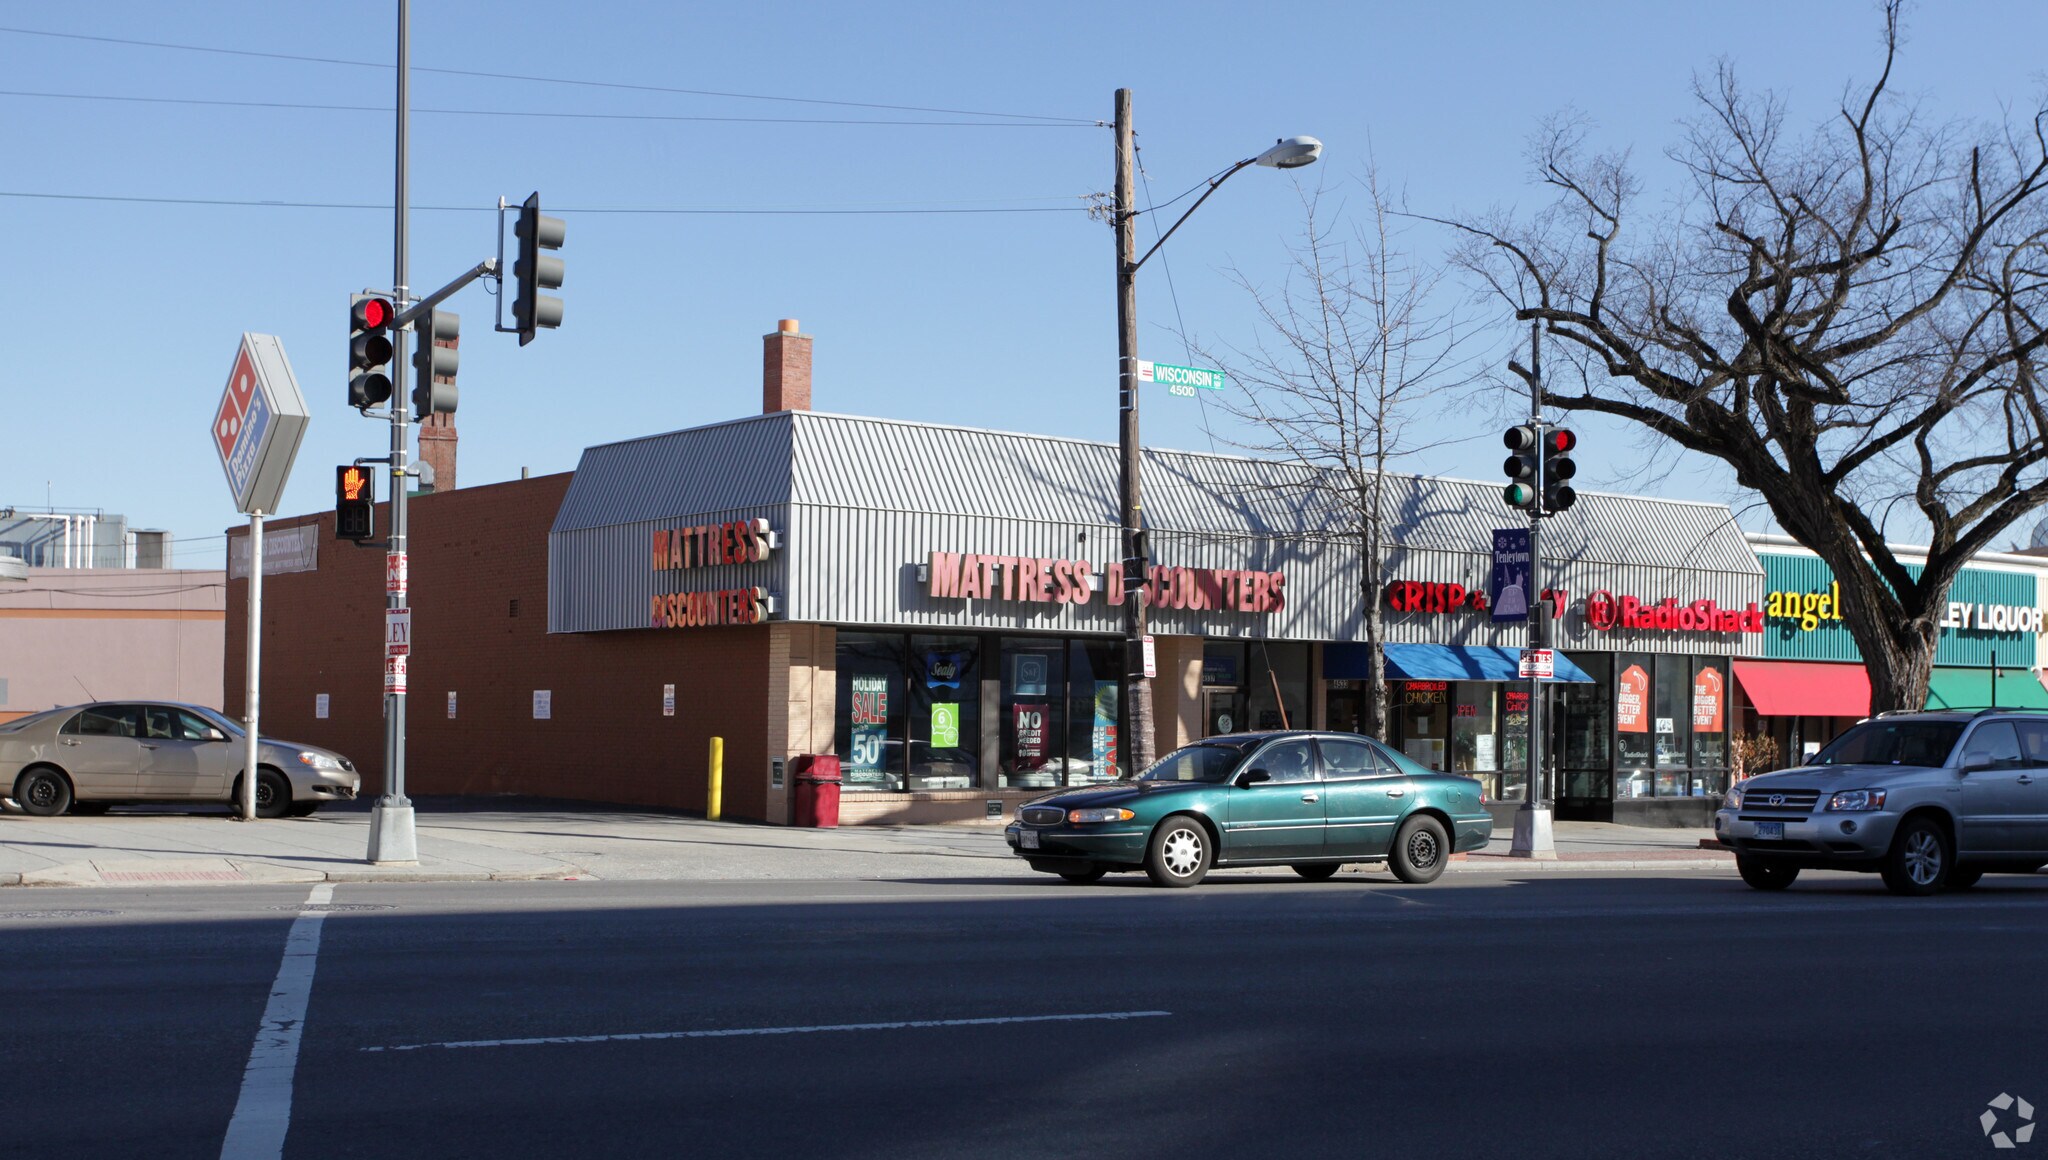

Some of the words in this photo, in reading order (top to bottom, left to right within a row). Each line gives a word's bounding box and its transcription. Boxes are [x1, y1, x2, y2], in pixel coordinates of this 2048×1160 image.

[1155, 366, 1212, 387] WISCONSIN
[1170, 385, 1195, 397] 4500
[231, 397, 262, 475] Domino's
[235, 444, 256, 490] Pizza
[653, 518, 769, 571] MATTRESS
[1495, 550, 1530, 564] Tenleytown
[929, 551, 1092, 605] MATTRESS
[1105, 562, 1286, 614] DSCOUNTERS
[1388, 580, 1466, 614] CRISP
[1472, 588, 1488, 611] &
[1768, 580, 1841, 632] angel
[652, 586, 768, 629] DISCOUNTERS
[1619, 595, 1765, 634] RadioShack
[1977, 603, 2044, 633] LIQUOR
[931, 661, 956, 679] Sealy
[853, 677, 887, 692] HOLIDAY
[1405, 681, 1447, 691] CHARBROILED
[1620, 683, 1631, 693] THE
[1695, 685, 1706, 694] THE
[1405, 691, 1447, 704] CHICKEN
[852, 692, 887, 725] SALE
[1618, 703, 1640, 715] BETTER
[1694, 705, 1716, 715] BETTER
[938, 711, 946, 725] 6
[1018, 711, 1042, 729] NO
[1693, 715, 1712, 725] EVENT
[1019, 729, 1042, 737] CREDIT
[1105, 725, 1117, 777] SALE
[1624, 750, 1648, 758] RadioShack
